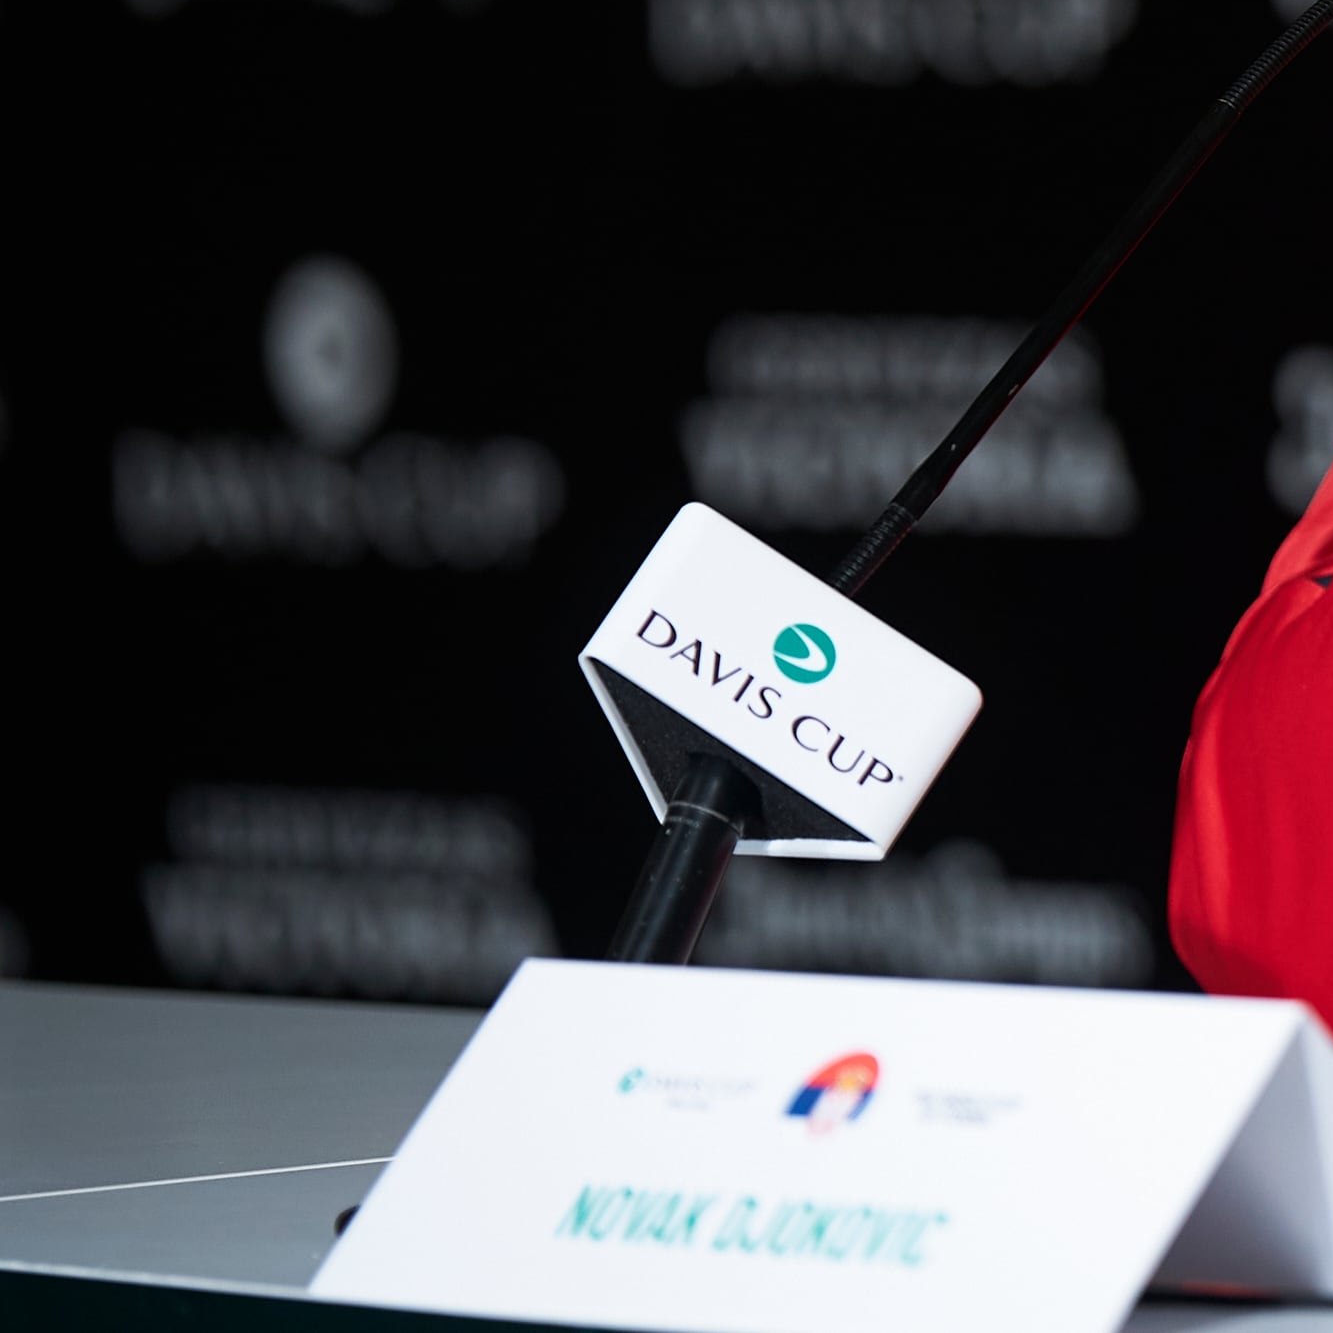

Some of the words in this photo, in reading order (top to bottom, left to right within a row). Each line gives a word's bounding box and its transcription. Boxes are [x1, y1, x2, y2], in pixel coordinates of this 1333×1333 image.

[635, 609, 782, 720] DAVIS
[791, 715, 895, 786] CUP
[554, 1182, 716, 1247] NOVAK
